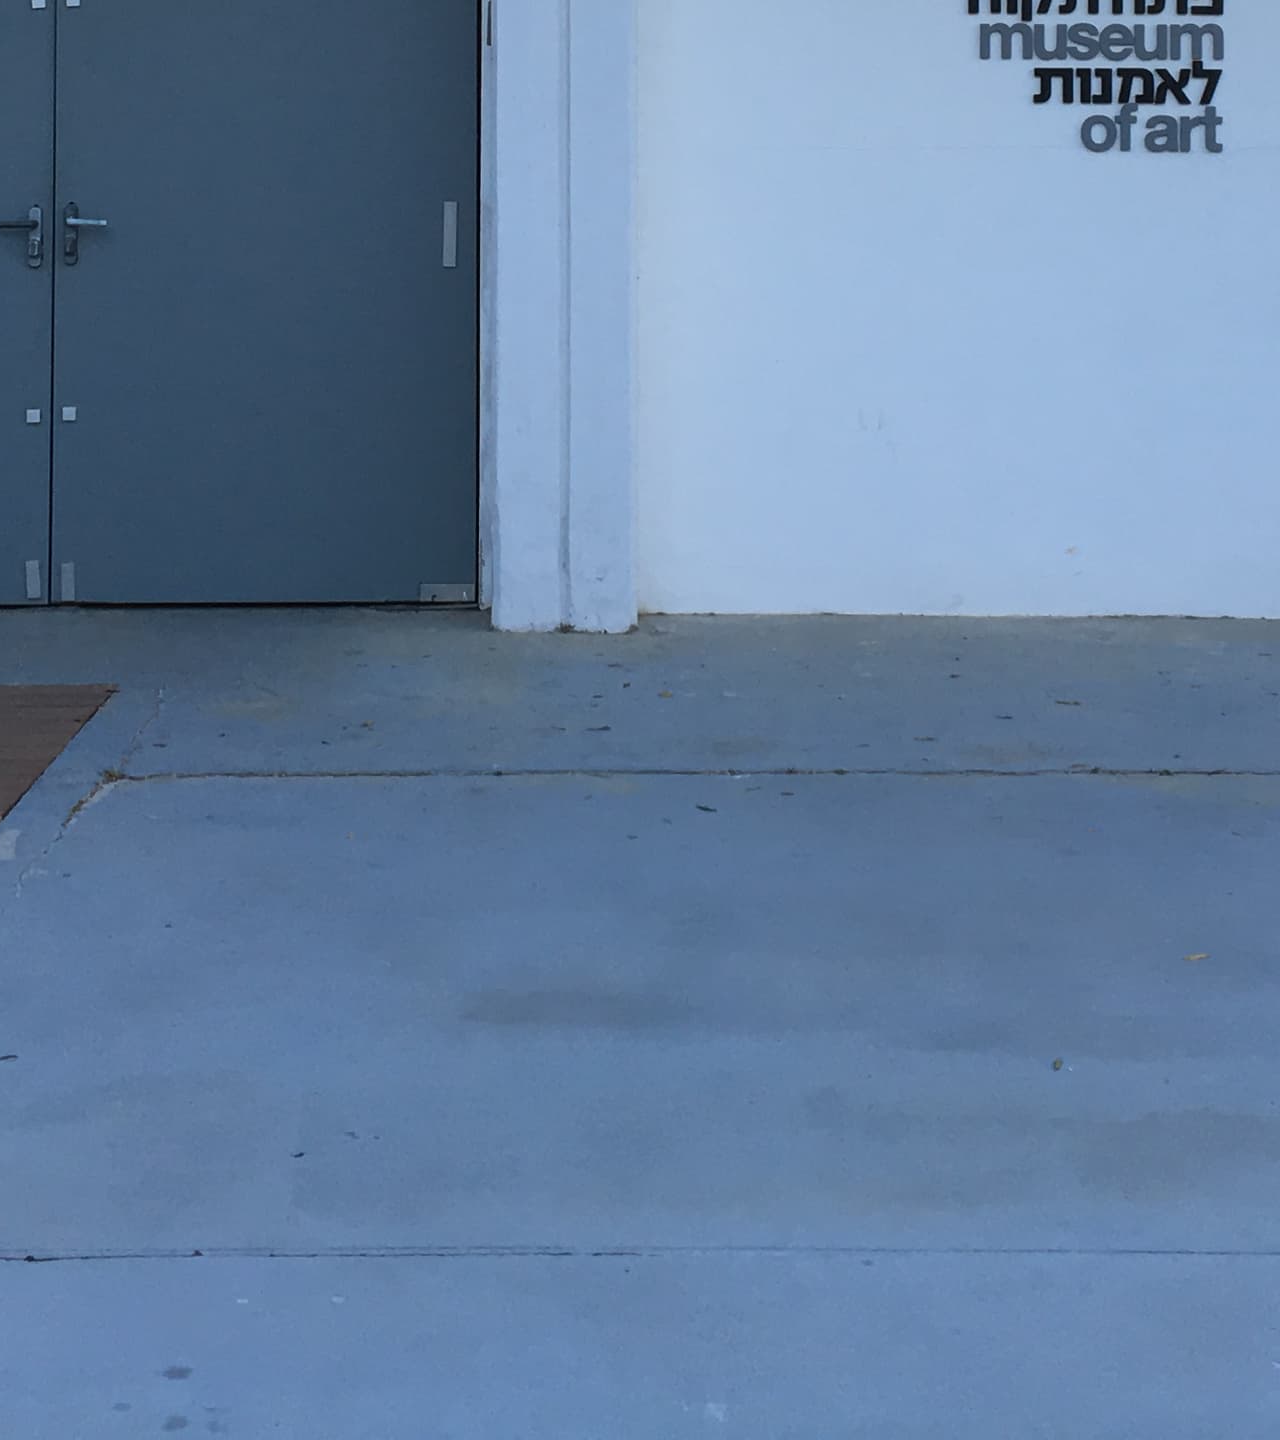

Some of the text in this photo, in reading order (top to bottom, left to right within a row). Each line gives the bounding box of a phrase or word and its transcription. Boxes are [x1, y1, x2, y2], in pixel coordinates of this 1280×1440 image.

[979, 22, 1224, 60] museum
[1033, 60, 1223, 104] לאמנות
[1081, 103, 1223, 153] of art
